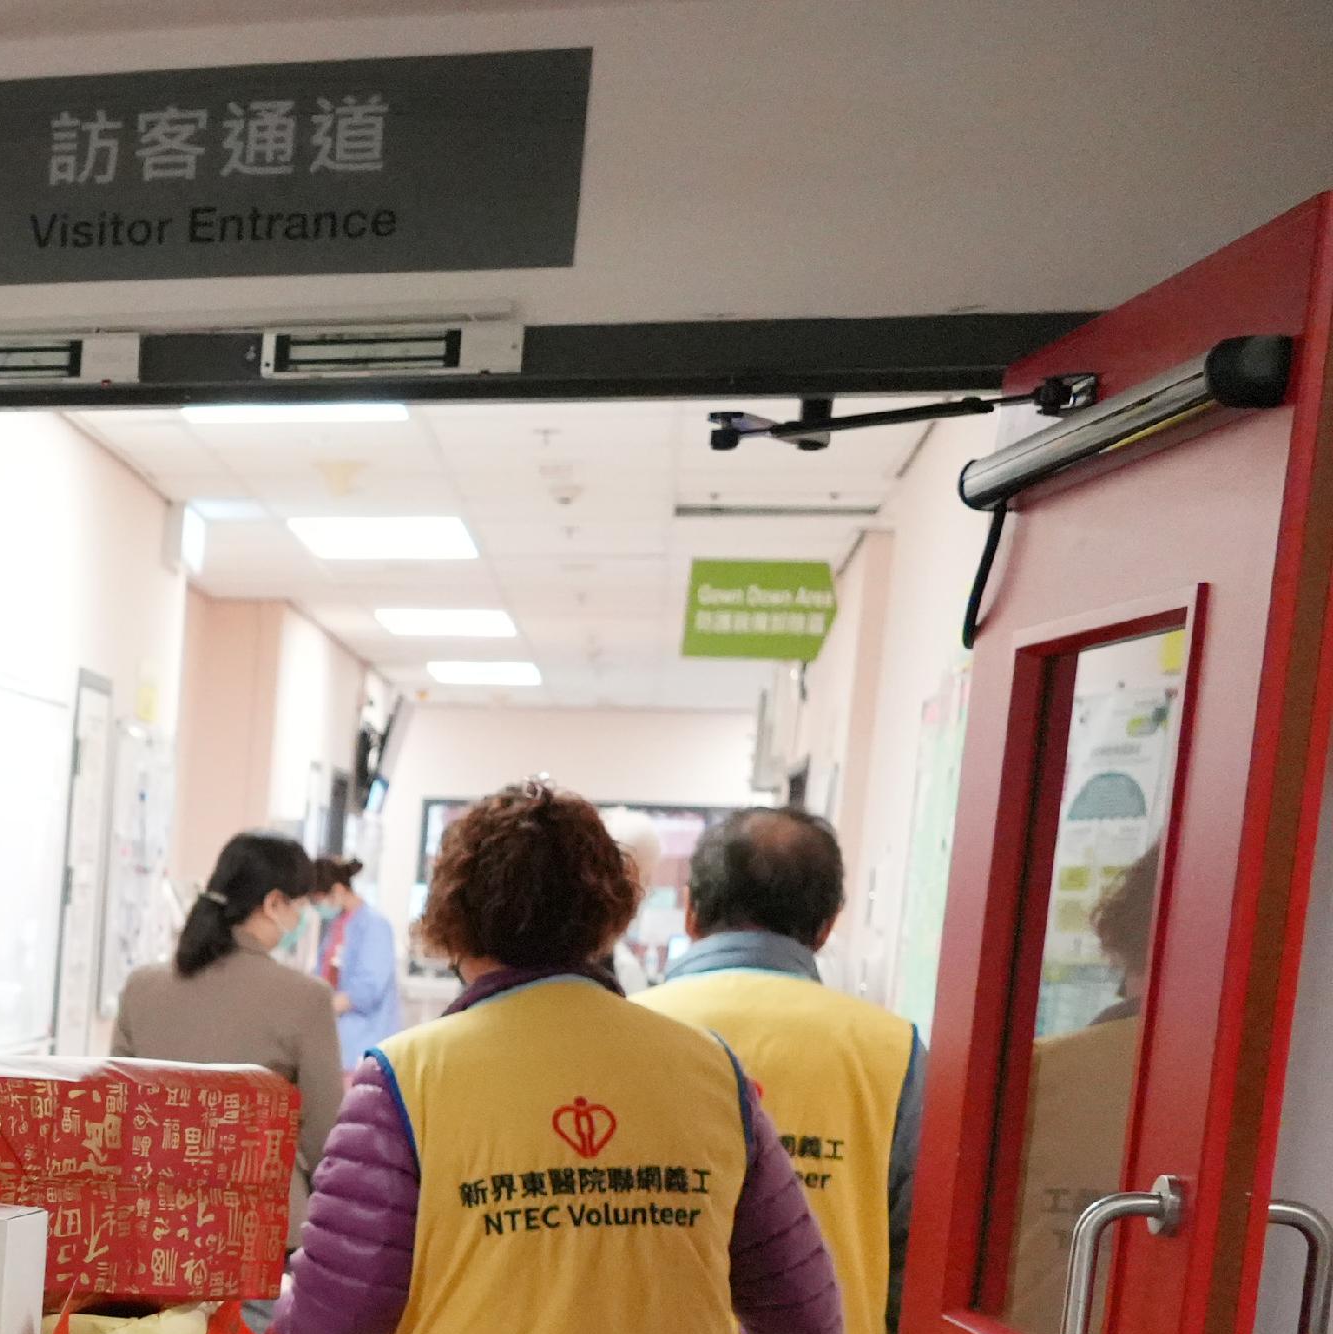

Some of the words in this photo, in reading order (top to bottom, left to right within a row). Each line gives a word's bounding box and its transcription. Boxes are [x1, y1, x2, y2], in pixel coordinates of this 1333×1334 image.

[47, 95, 390, 187] 訪客通道
[31, 209, 172, 249] Visitor
[189, 205, 397, 244] Entrance
[459, 1166, 711, 1208] 新界東醫院聯網義工
[484, 1205, 561, 1235] NTEC
[568, 1203, 701, 1228] Volunteer
